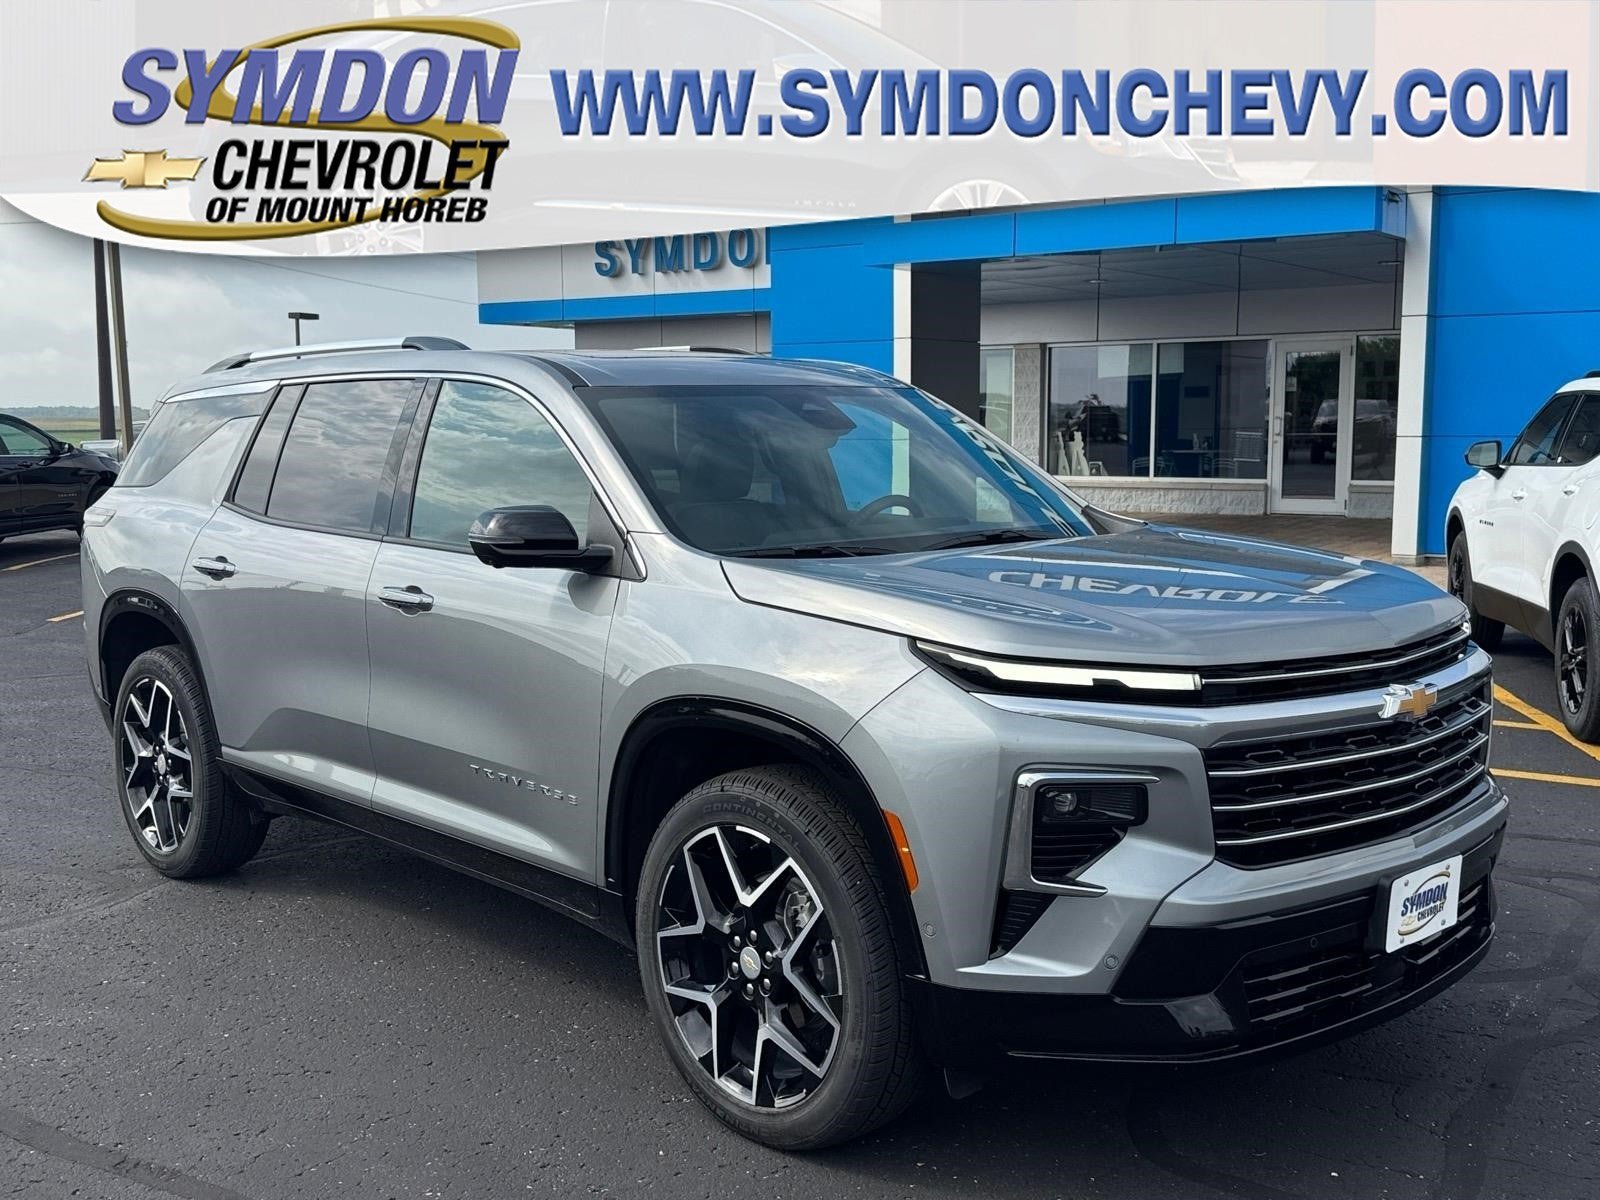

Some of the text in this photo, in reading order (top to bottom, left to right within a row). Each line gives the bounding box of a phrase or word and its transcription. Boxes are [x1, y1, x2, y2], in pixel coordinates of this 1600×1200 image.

[469, 764, 579, 806] TRAVERSE
[1401, 882, 1448, 917] SYMDON
[1417, 902, 1446, 922] CHEVROLET
